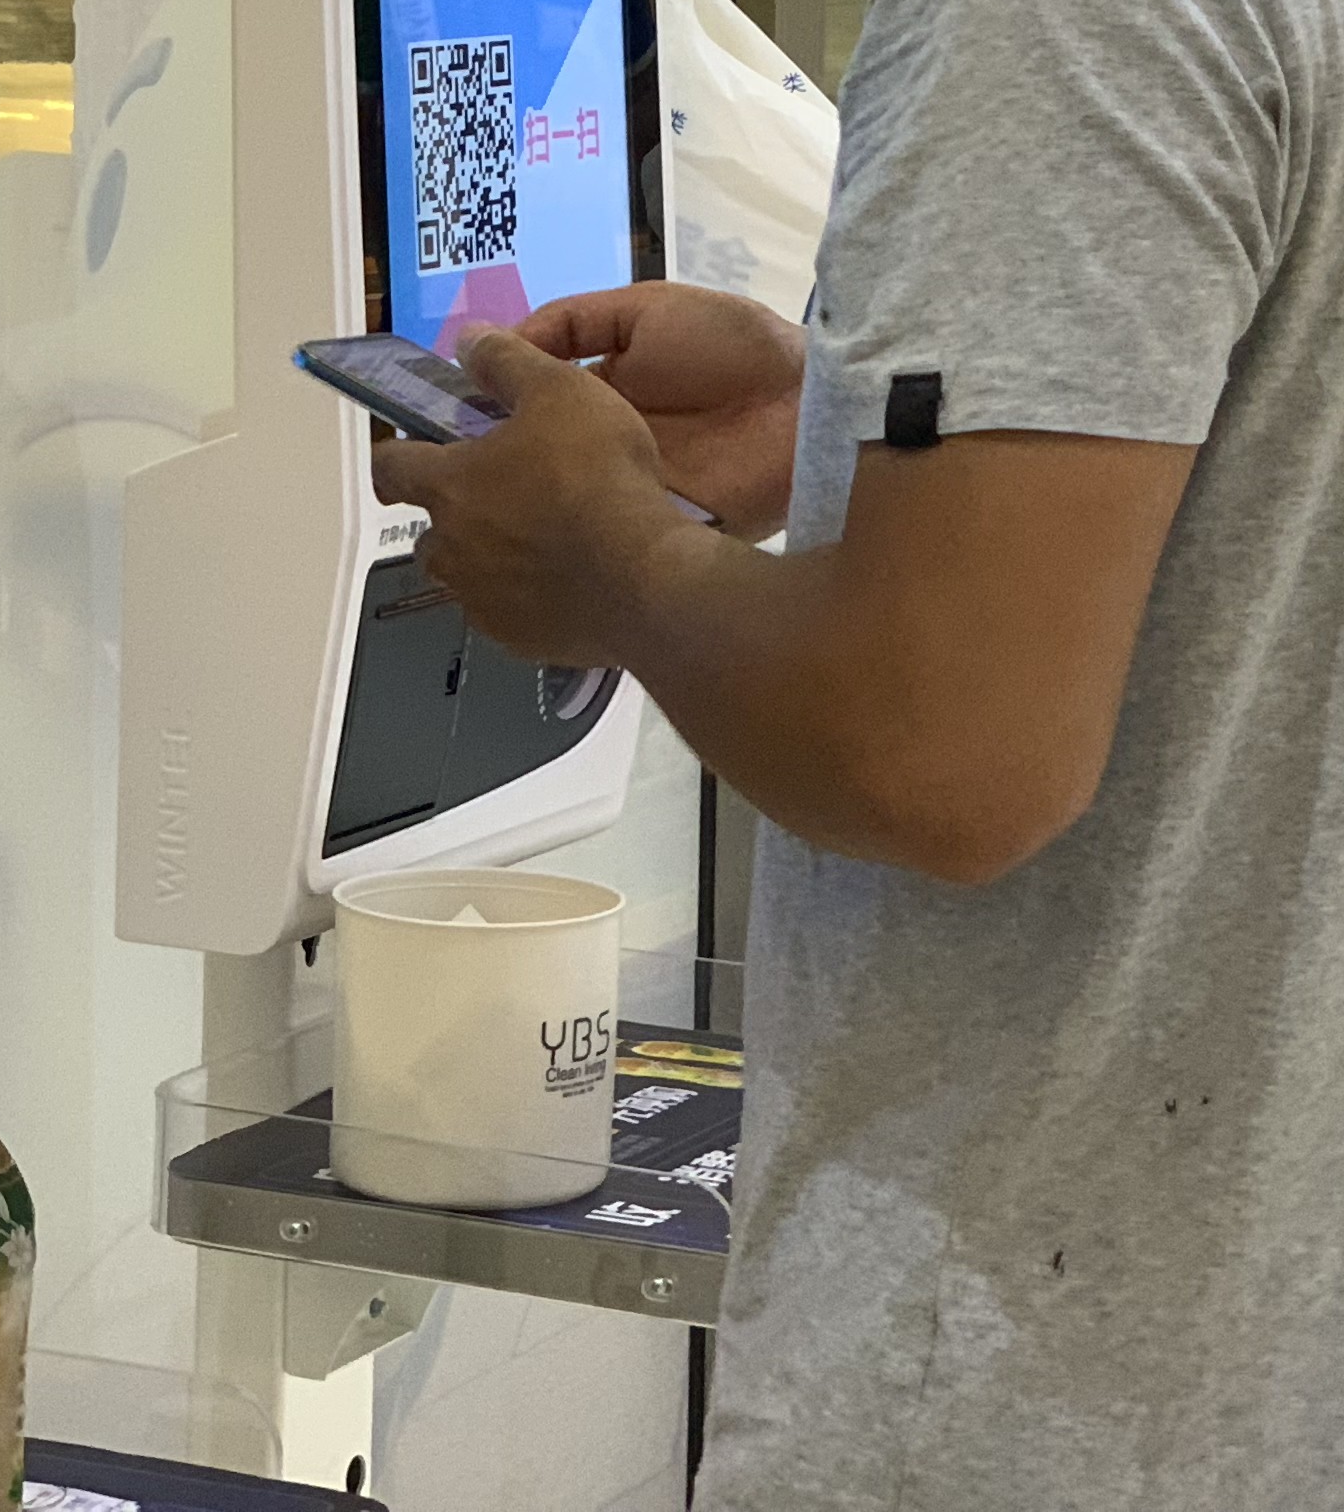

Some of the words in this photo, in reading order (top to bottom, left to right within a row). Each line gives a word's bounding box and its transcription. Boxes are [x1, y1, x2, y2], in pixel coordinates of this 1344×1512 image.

[527, 107, 601, 166] 扫一扫
[541, 1009, 610, 1065] YBS
[545, 1064, 582, 1083] Clean
